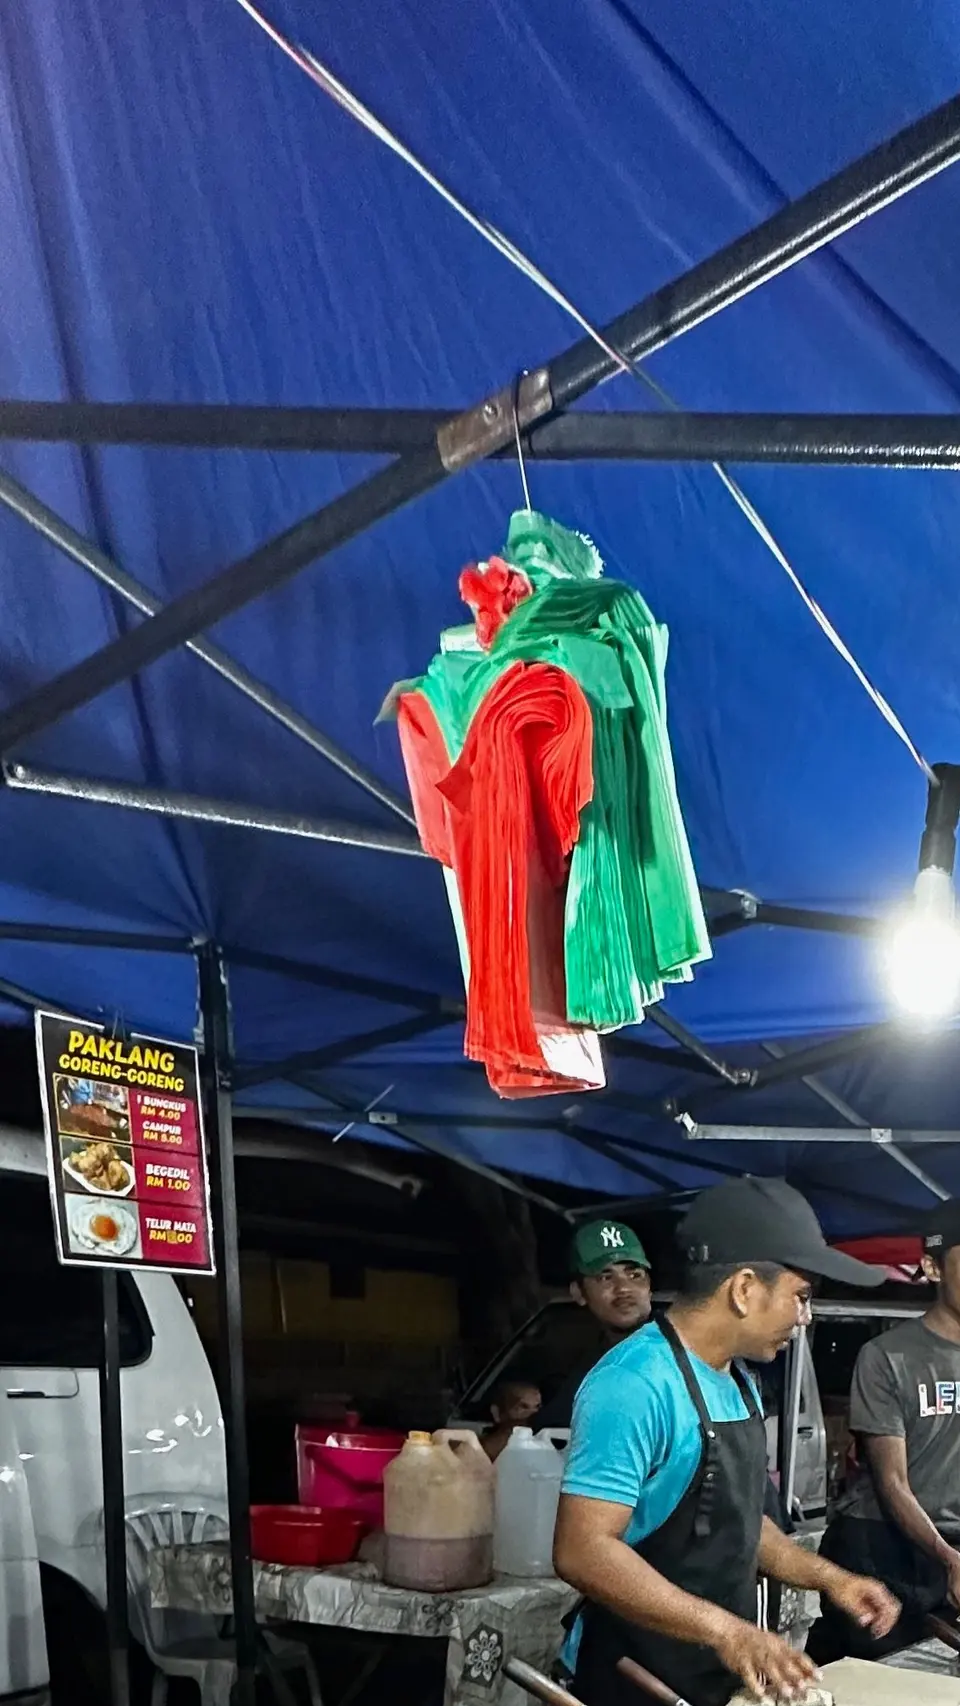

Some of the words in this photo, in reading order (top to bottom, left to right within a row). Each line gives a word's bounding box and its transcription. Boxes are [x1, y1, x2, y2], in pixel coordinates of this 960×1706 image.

[69, 1030, 175, 1072] PAKLANG
[59, 1054, 185, 1092] GORENG-GORENG
[143, 1095, 187, 1113] BUNGKUS
[141, 1105, 156, 1116] RM
[159, 1108, 181, 1121] 4.00
[142, 1121, 182, 1135] CAMPUR
[143, 1130, 158, 1141] RM
[146, 1163, 190, 1180] BEGEDIL
[147, 1177, 164, 1188] RM
[167, 1179, 191, 1191] 1.00
[145, 1217, 172, 1230] TELUR
[173, 1221, 197, 1233] MATA
[600, 1226, 625, 1247] NY
